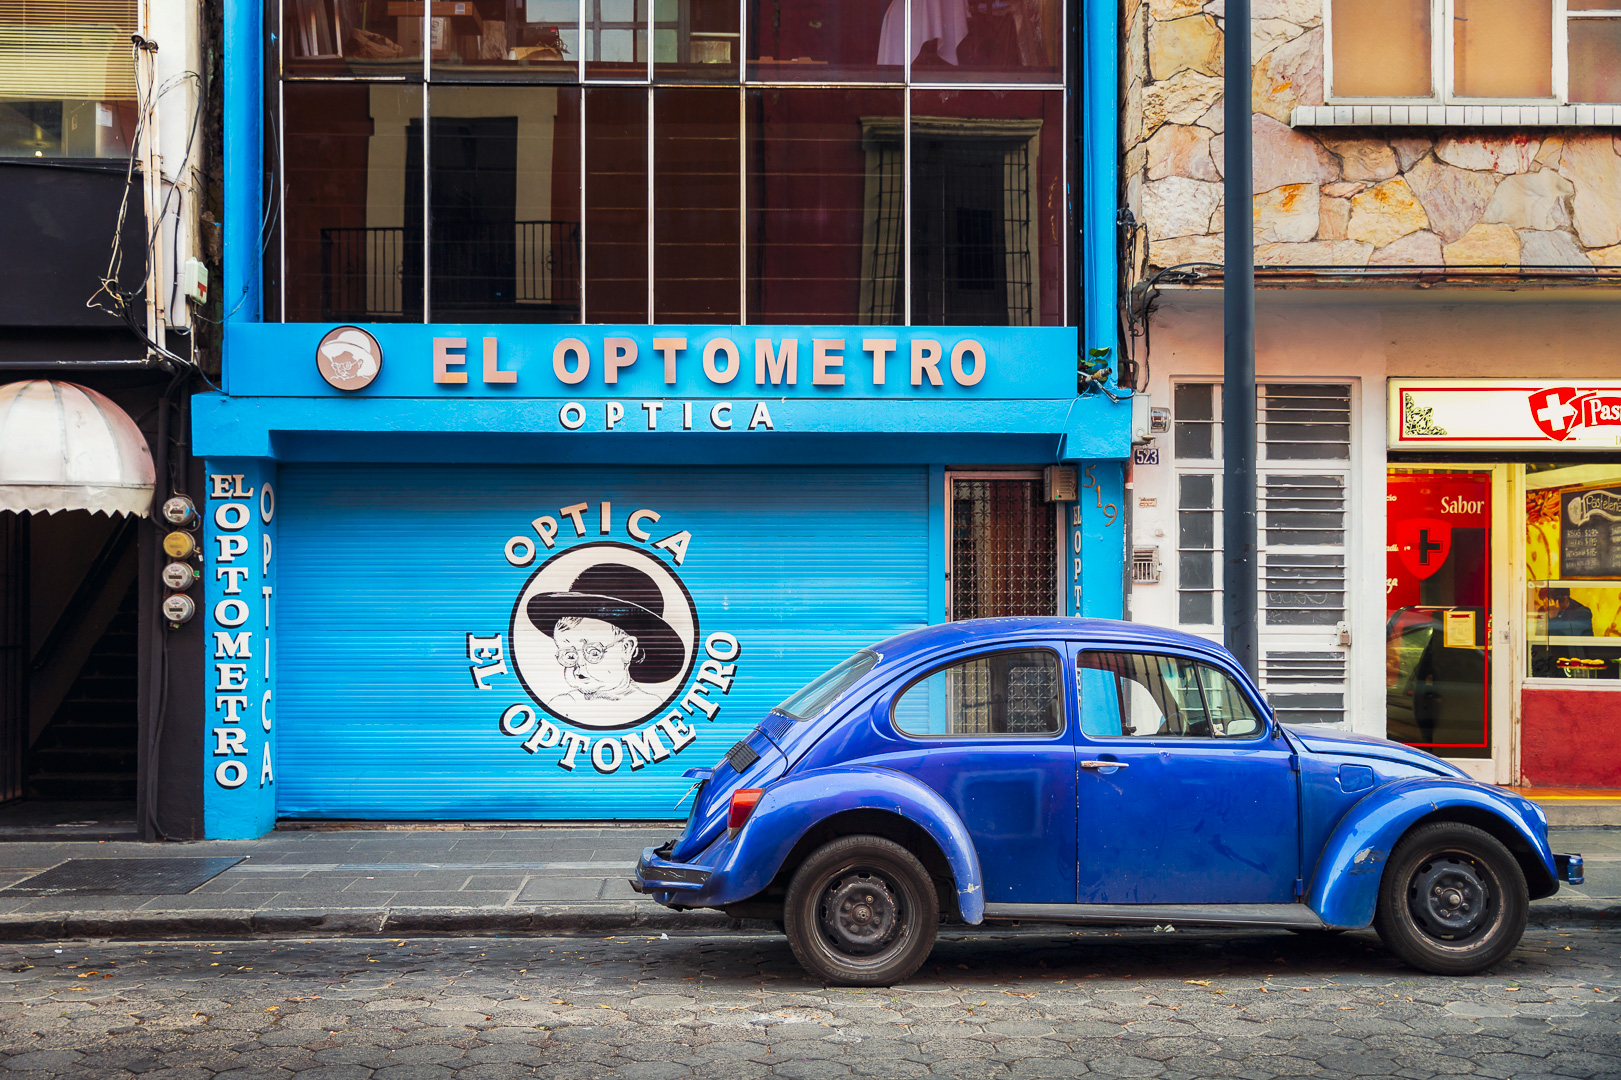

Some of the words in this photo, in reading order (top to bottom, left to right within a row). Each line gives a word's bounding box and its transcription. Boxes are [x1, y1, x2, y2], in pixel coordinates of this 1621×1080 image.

[432, 337, 517, 384] EL
[552, 337, 987, 387] OPTOMETRO
[559, 401, 774, 430] OPTICA
[1589, 399, 1621, 425] Pas
[1136, 448, 1158, 465] 523
[210, 474, 254, 498] EL
[1083, 464, 1118, 527] 519
[1440, 495, 1485, 515] Sabor
[504, 501, 692, 568] OPTICA
[1073, 505, 1082, 527] EL
[1073, 530, 1082, 617] OPT
[213, 503, 253, 789] OPTOMETRO
[260, 482, 275, 789] OPTICA
[466, 632, 508, 690] EL
[499, 632, 741, 774] OPTOMETRO
